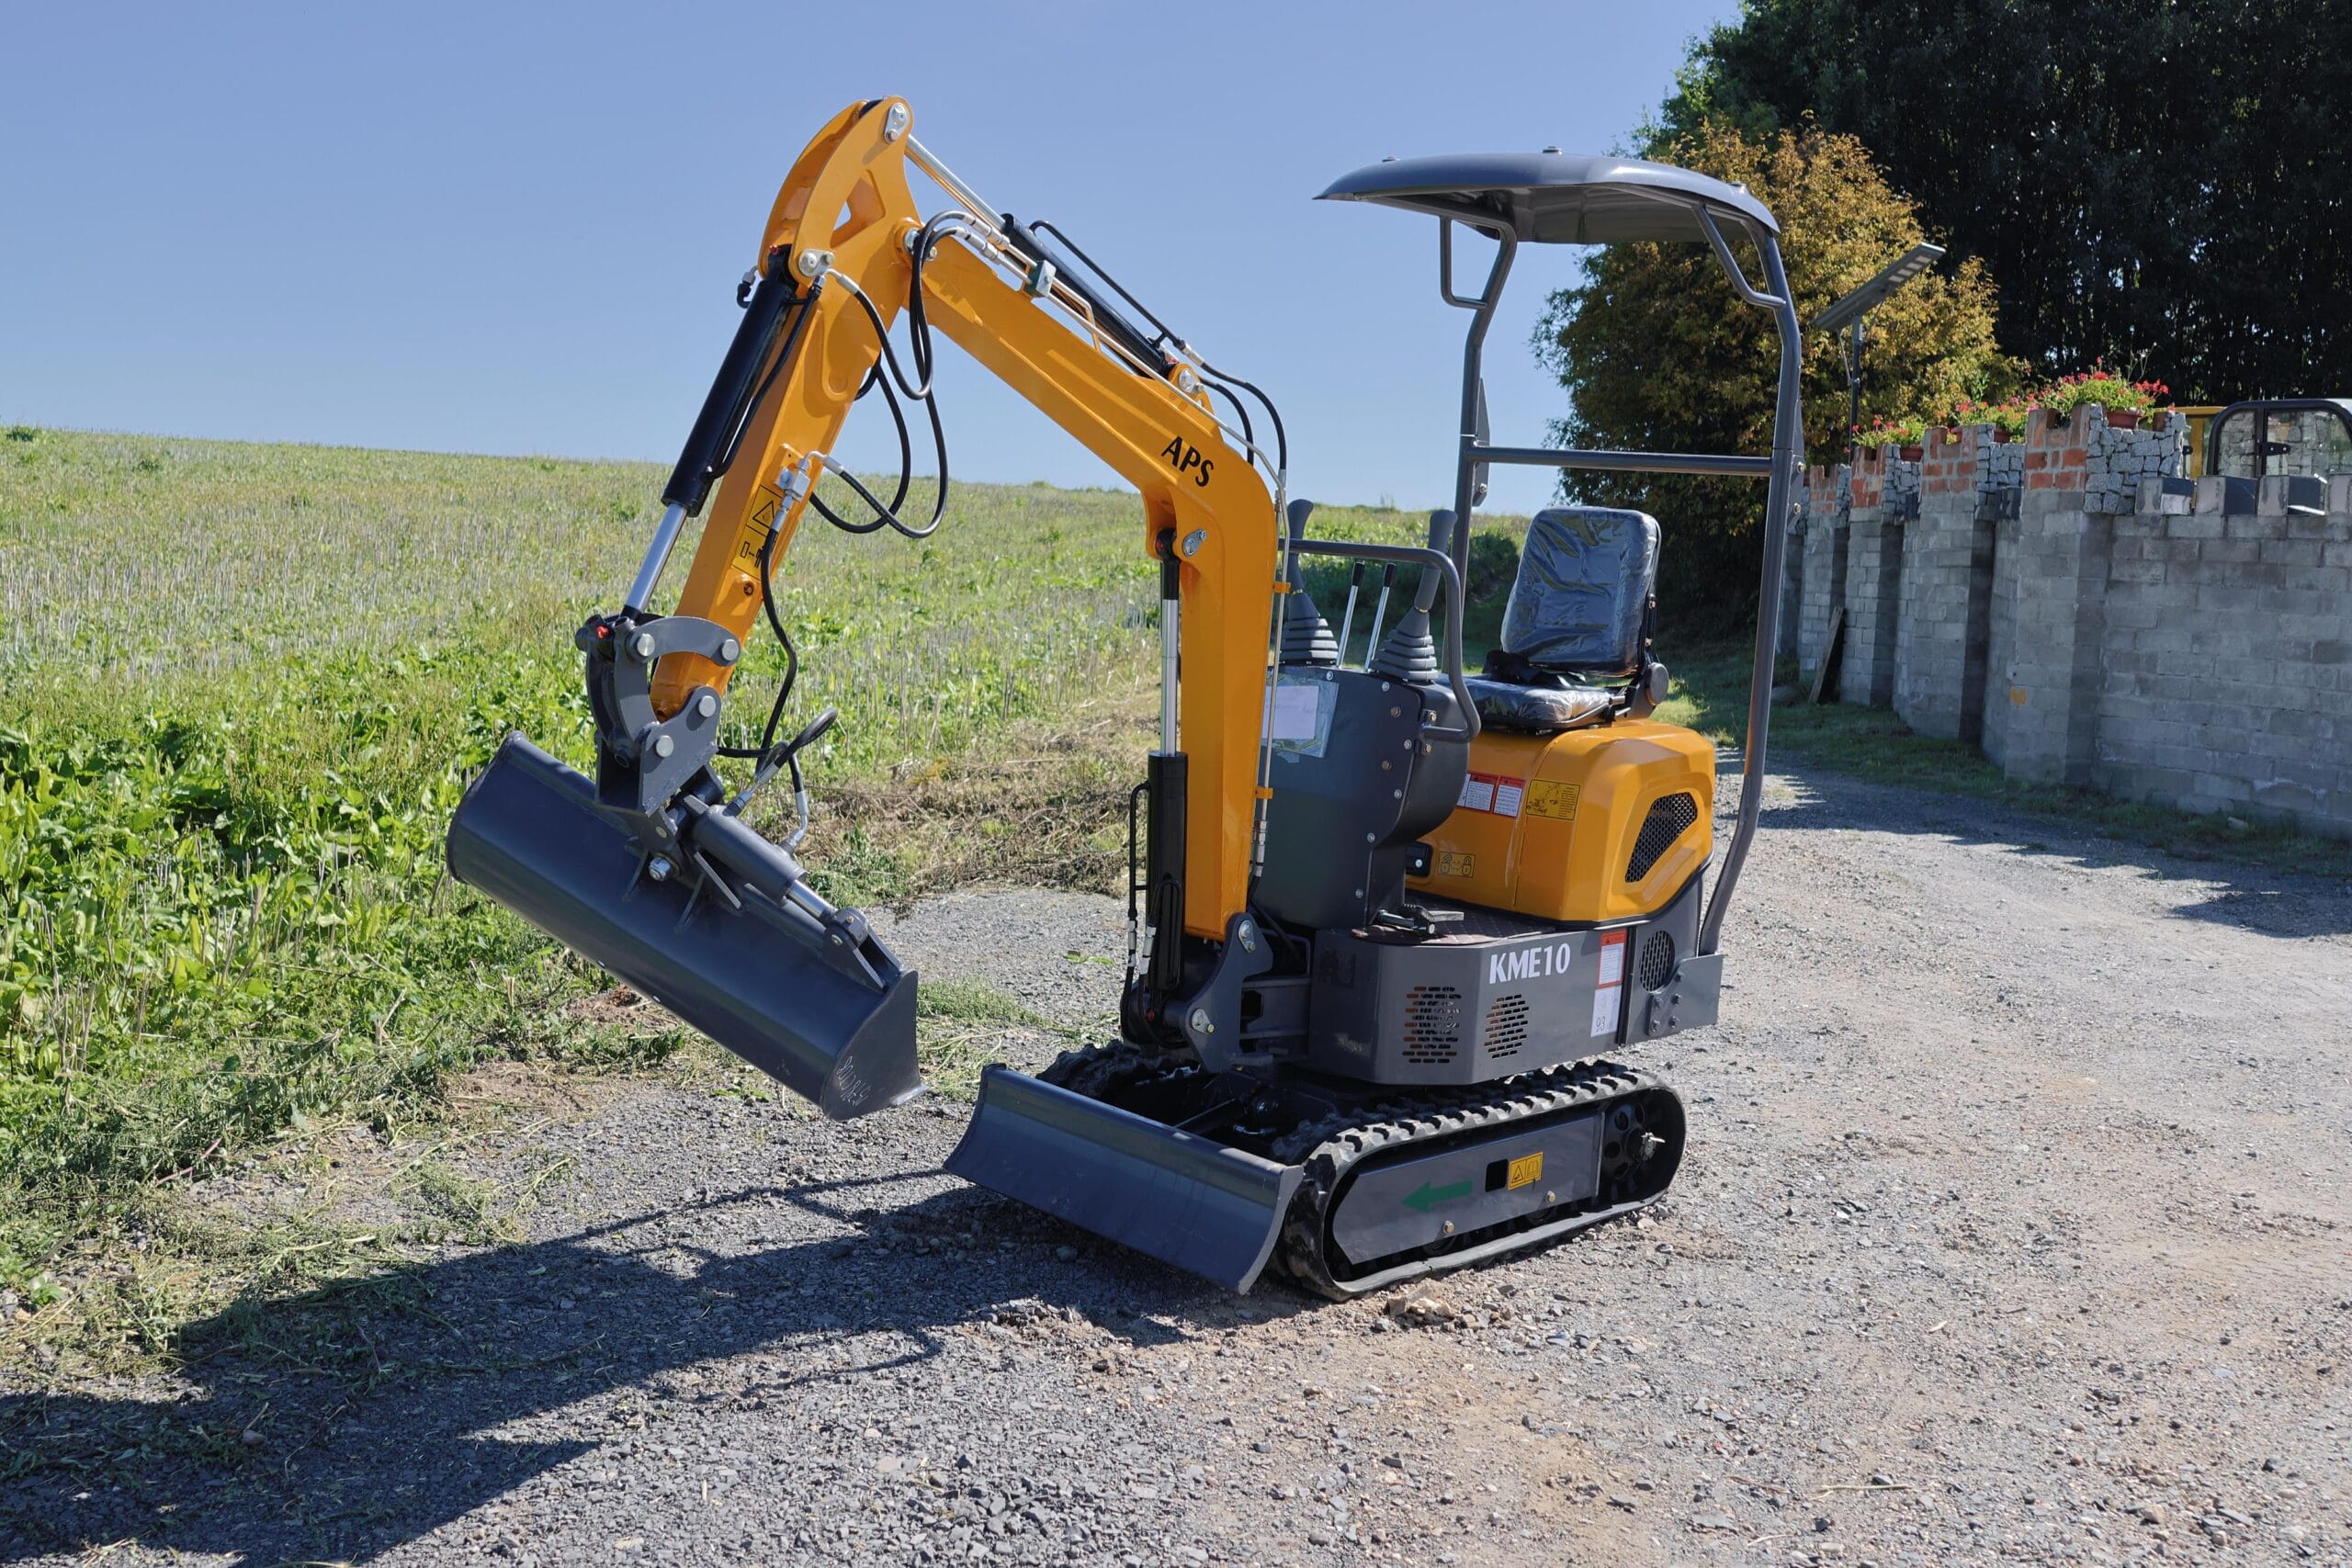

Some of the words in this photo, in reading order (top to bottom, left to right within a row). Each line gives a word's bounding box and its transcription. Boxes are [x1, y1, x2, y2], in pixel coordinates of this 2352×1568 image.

[1161, 435, 1215, 488] APS
[1489, 942, 1571, 985] KME10
[1595, 1015, 1606, 1032] 93
